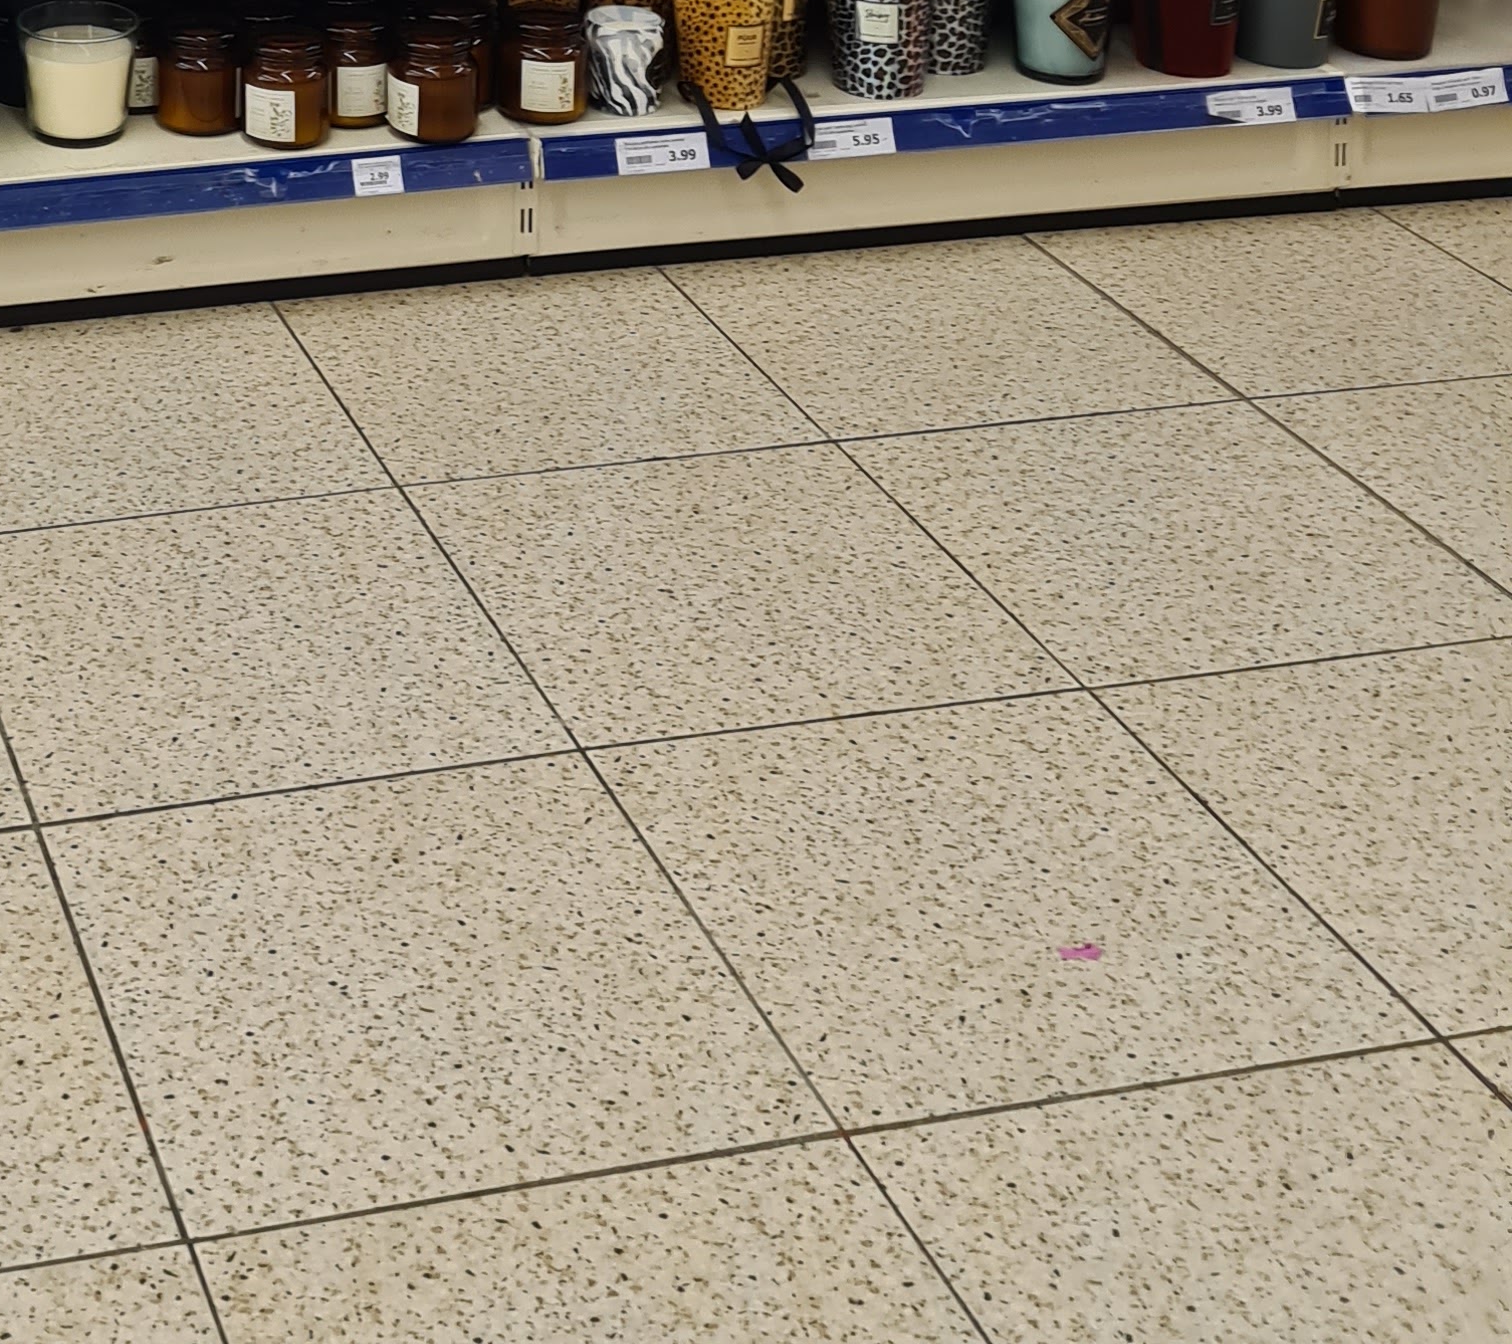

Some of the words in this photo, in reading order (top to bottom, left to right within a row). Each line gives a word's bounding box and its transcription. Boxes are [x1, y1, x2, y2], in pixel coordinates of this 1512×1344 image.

[1471, 85, 1495, 98] 0.97
[1257, 105, 1282, 116] 3.99
[853, 134, 880, 146] 5.95
[669, 149, 696, 161] 3.99
